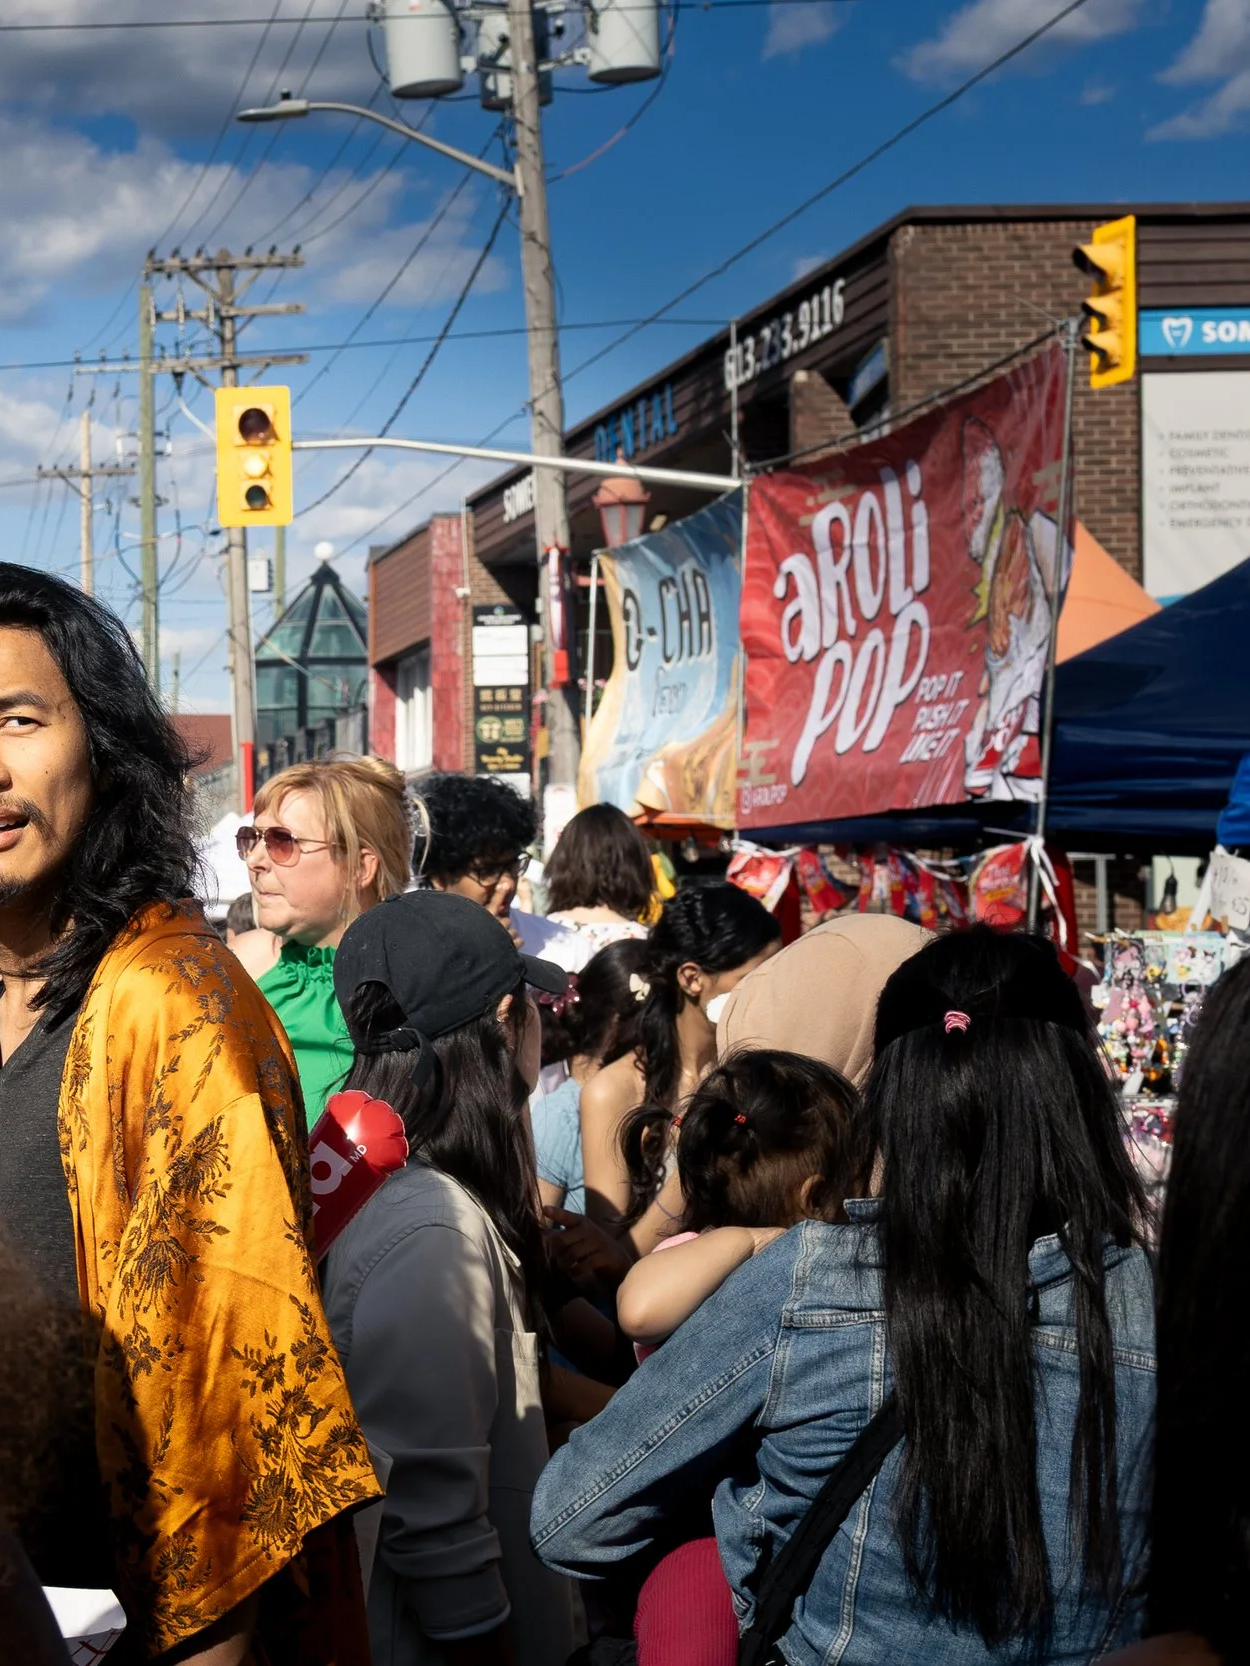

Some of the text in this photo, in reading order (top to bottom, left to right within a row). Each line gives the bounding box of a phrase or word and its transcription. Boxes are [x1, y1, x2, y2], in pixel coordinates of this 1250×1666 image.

[594, 383, 678, 464] DENTAL
[791, 600, 931, 787] POP
[914, 673, 948, 704] POP
[350, 1144, 367, 1163] MD
